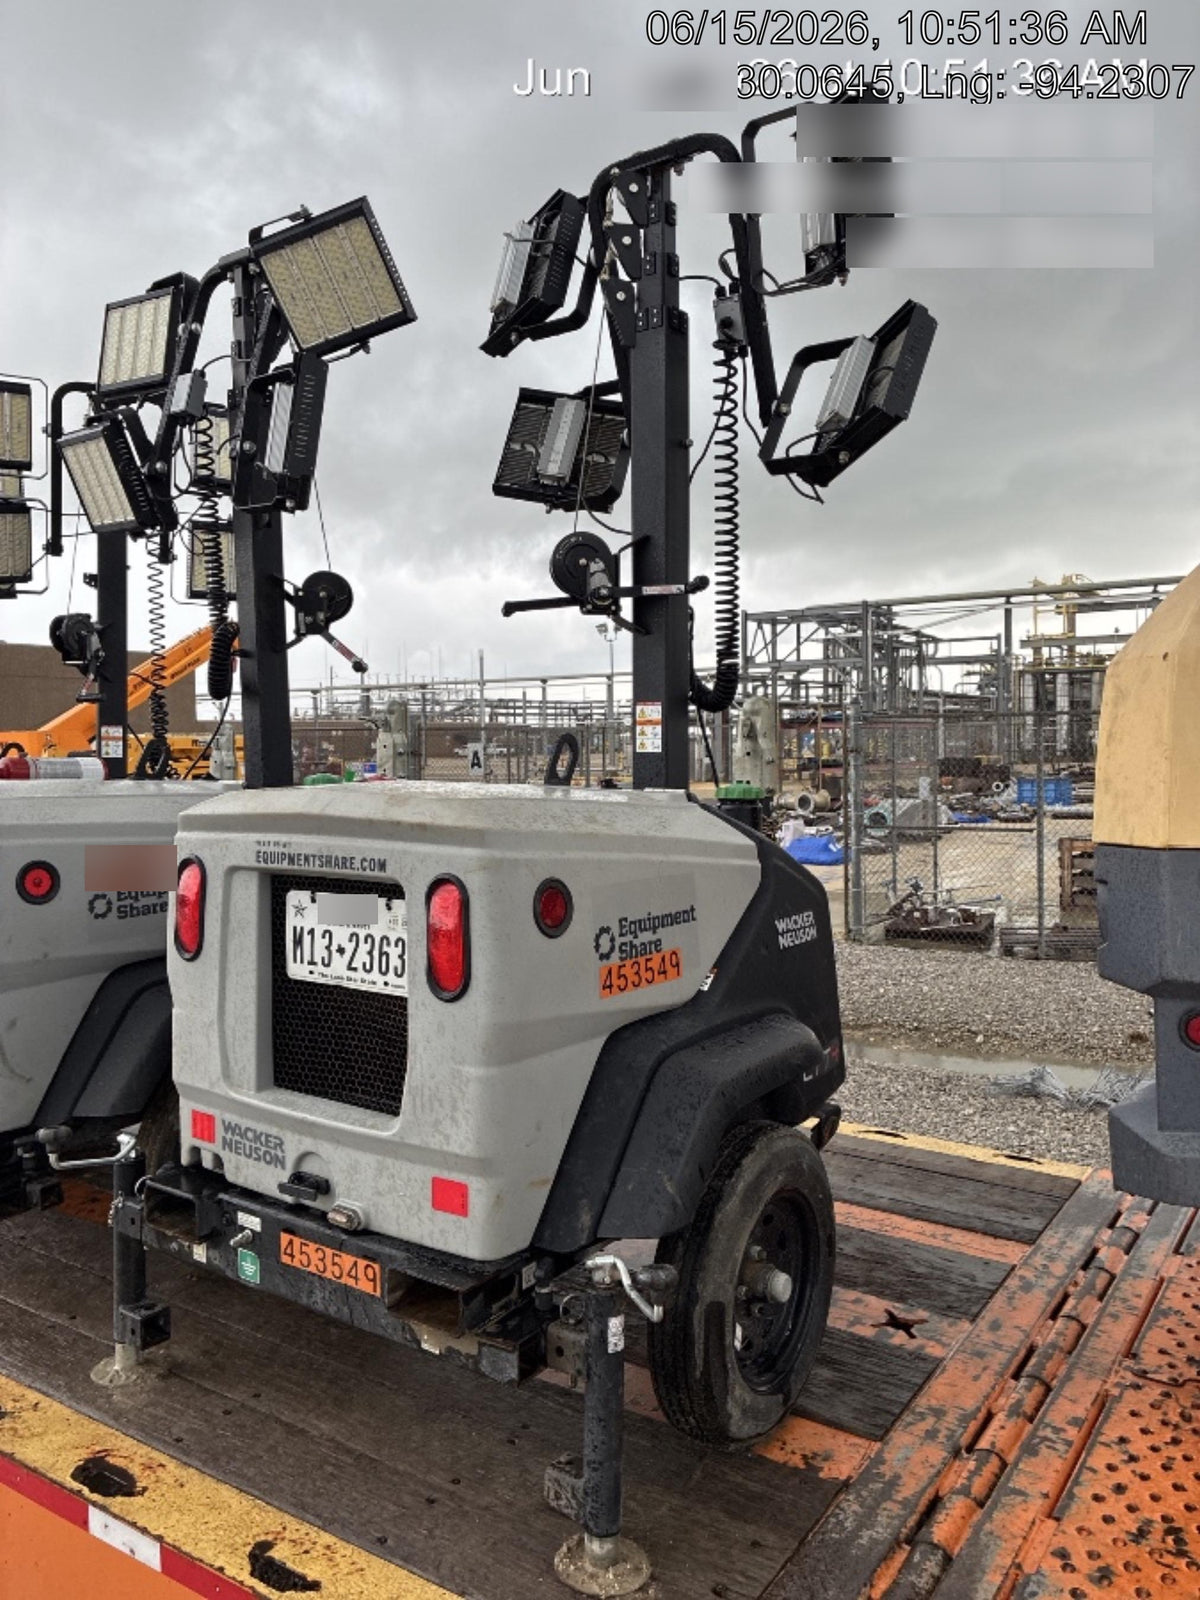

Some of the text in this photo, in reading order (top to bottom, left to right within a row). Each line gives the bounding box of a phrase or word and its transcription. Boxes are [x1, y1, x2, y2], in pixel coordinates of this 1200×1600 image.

[471, 750, 482, 768] A
[255, 850, 388, 873] EQUIPMENTSHARE.COM
[117, 901, 168, 919] Share
[618, 904, 697, 939] Equipment
[774, 911, 815, 934] WACKER
[618, 938, 663, 961] Share
[778, 926, 817, 950] NEUSON
[602, 950, 681, 995] 453549
[221, 1118, 286, 1154] WACKER
[221, 1135, 286, 1171] NEUSON
[283, 1237, 378, 1293] 453549
